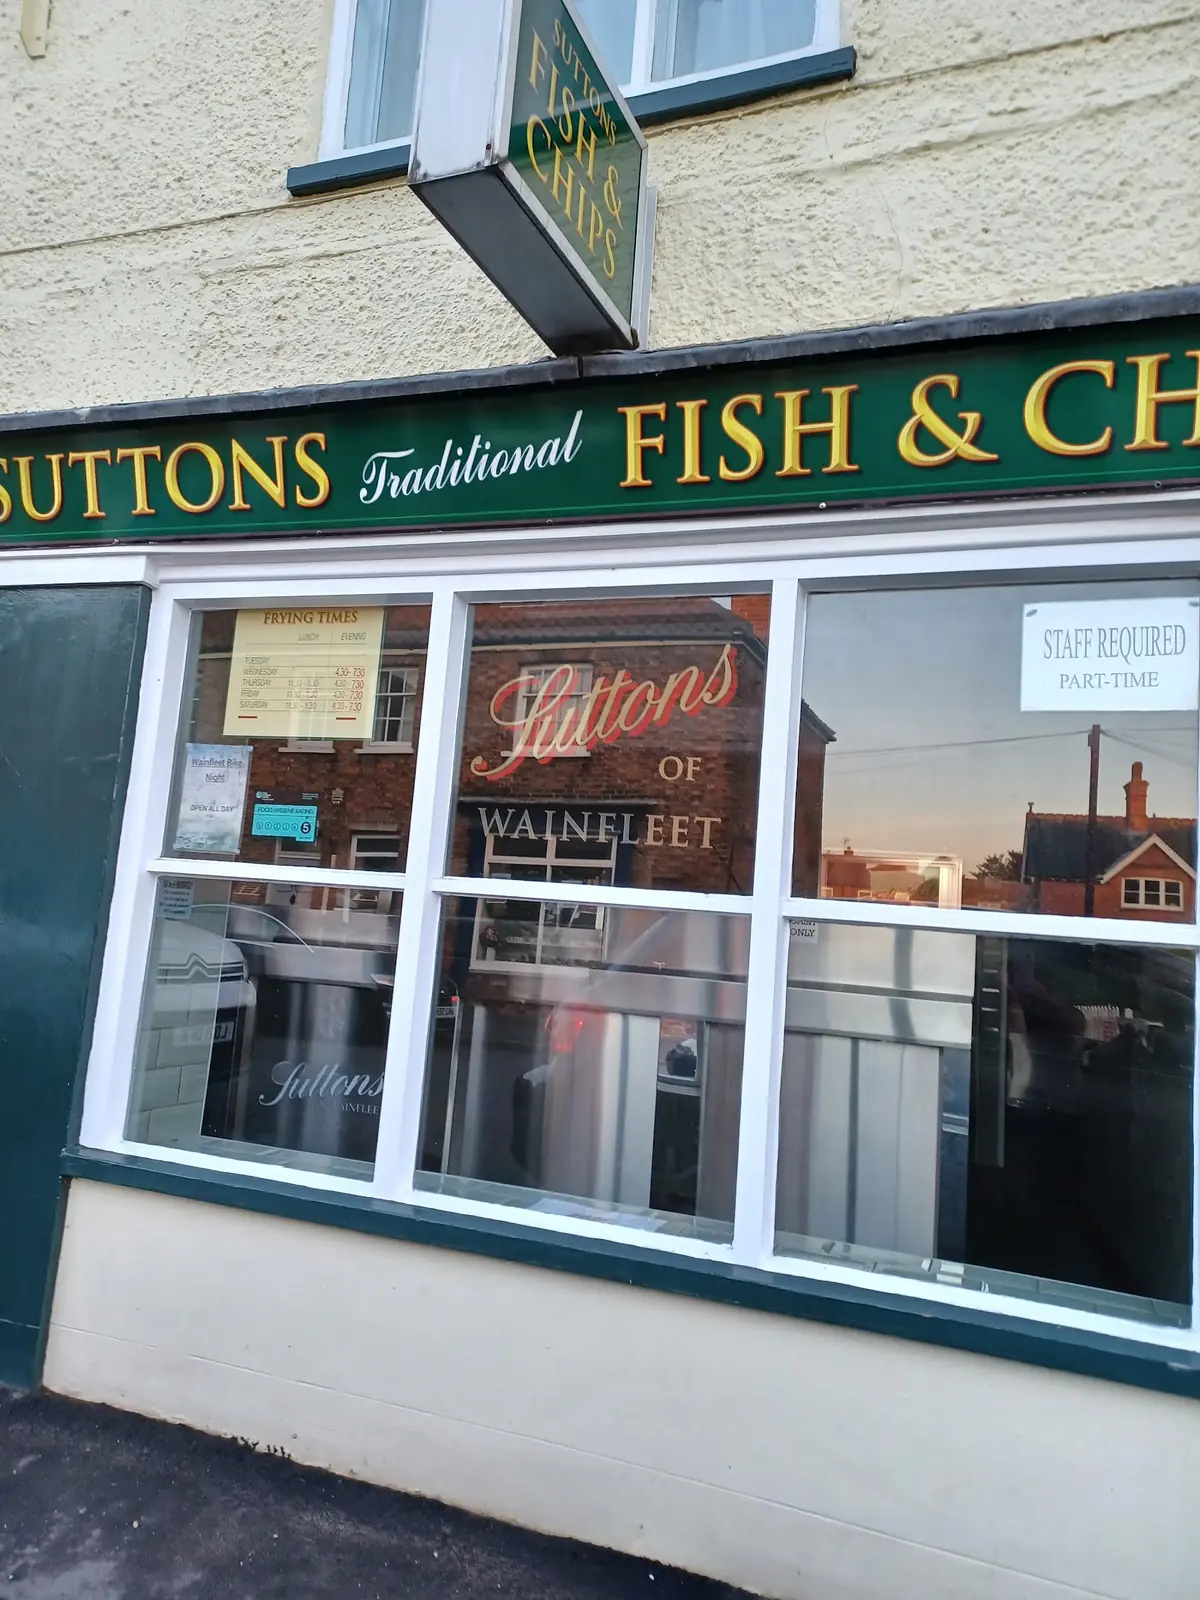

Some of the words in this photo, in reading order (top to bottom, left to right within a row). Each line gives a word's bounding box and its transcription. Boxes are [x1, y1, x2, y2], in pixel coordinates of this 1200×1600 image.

[552, 18, 617, 146] SUTTONS
[528, 26, 600, 186] FISH
[603, 165, 623, 231] &
[526, 114, 617, 280] CHIPS
[359, 409, 584, 504] Traditional
[617, 384, 861, 488] FISH
[898, 373, 999, 467] &
[263, 611, 314, 625] FRYING
[317, 610, 358, 624] TIMES
[298, 633, 319, 642] LUNCH
[340, 632, 367, 642] EVENING
[1043, 628, 1093, 659] STAFF
[1097, 624, 1187, 665] REQUIRED
[245, 656, 270, 665] TUESDAY
[243, 667, 278, 676] WEDNESDAY
[242, 679, 272, 687] THURSDAY
[1059, 671, 1160, 689] PART-TIME
[240, 689, 260, 698] FRIDAY
[239, 700, 268, 709] SATURDAY
[470, 643, 738, 780] Suttons
[191, 757, 225, 768] Wainfleet
[227, 758, 243, 768] Bike
[658, 756, 702, 781] OF
[205, 773, 225, 782] Night
[190, 804, 207, 812] OPEN
[208, 805, 220, 813] ALL
[221, 805, 235, 813] DAY
[477, 807, 722, 849] WAINFLEET
[790, 927, 816, 937] ONLY
[258, 1061, 385, 1106] Suttons
